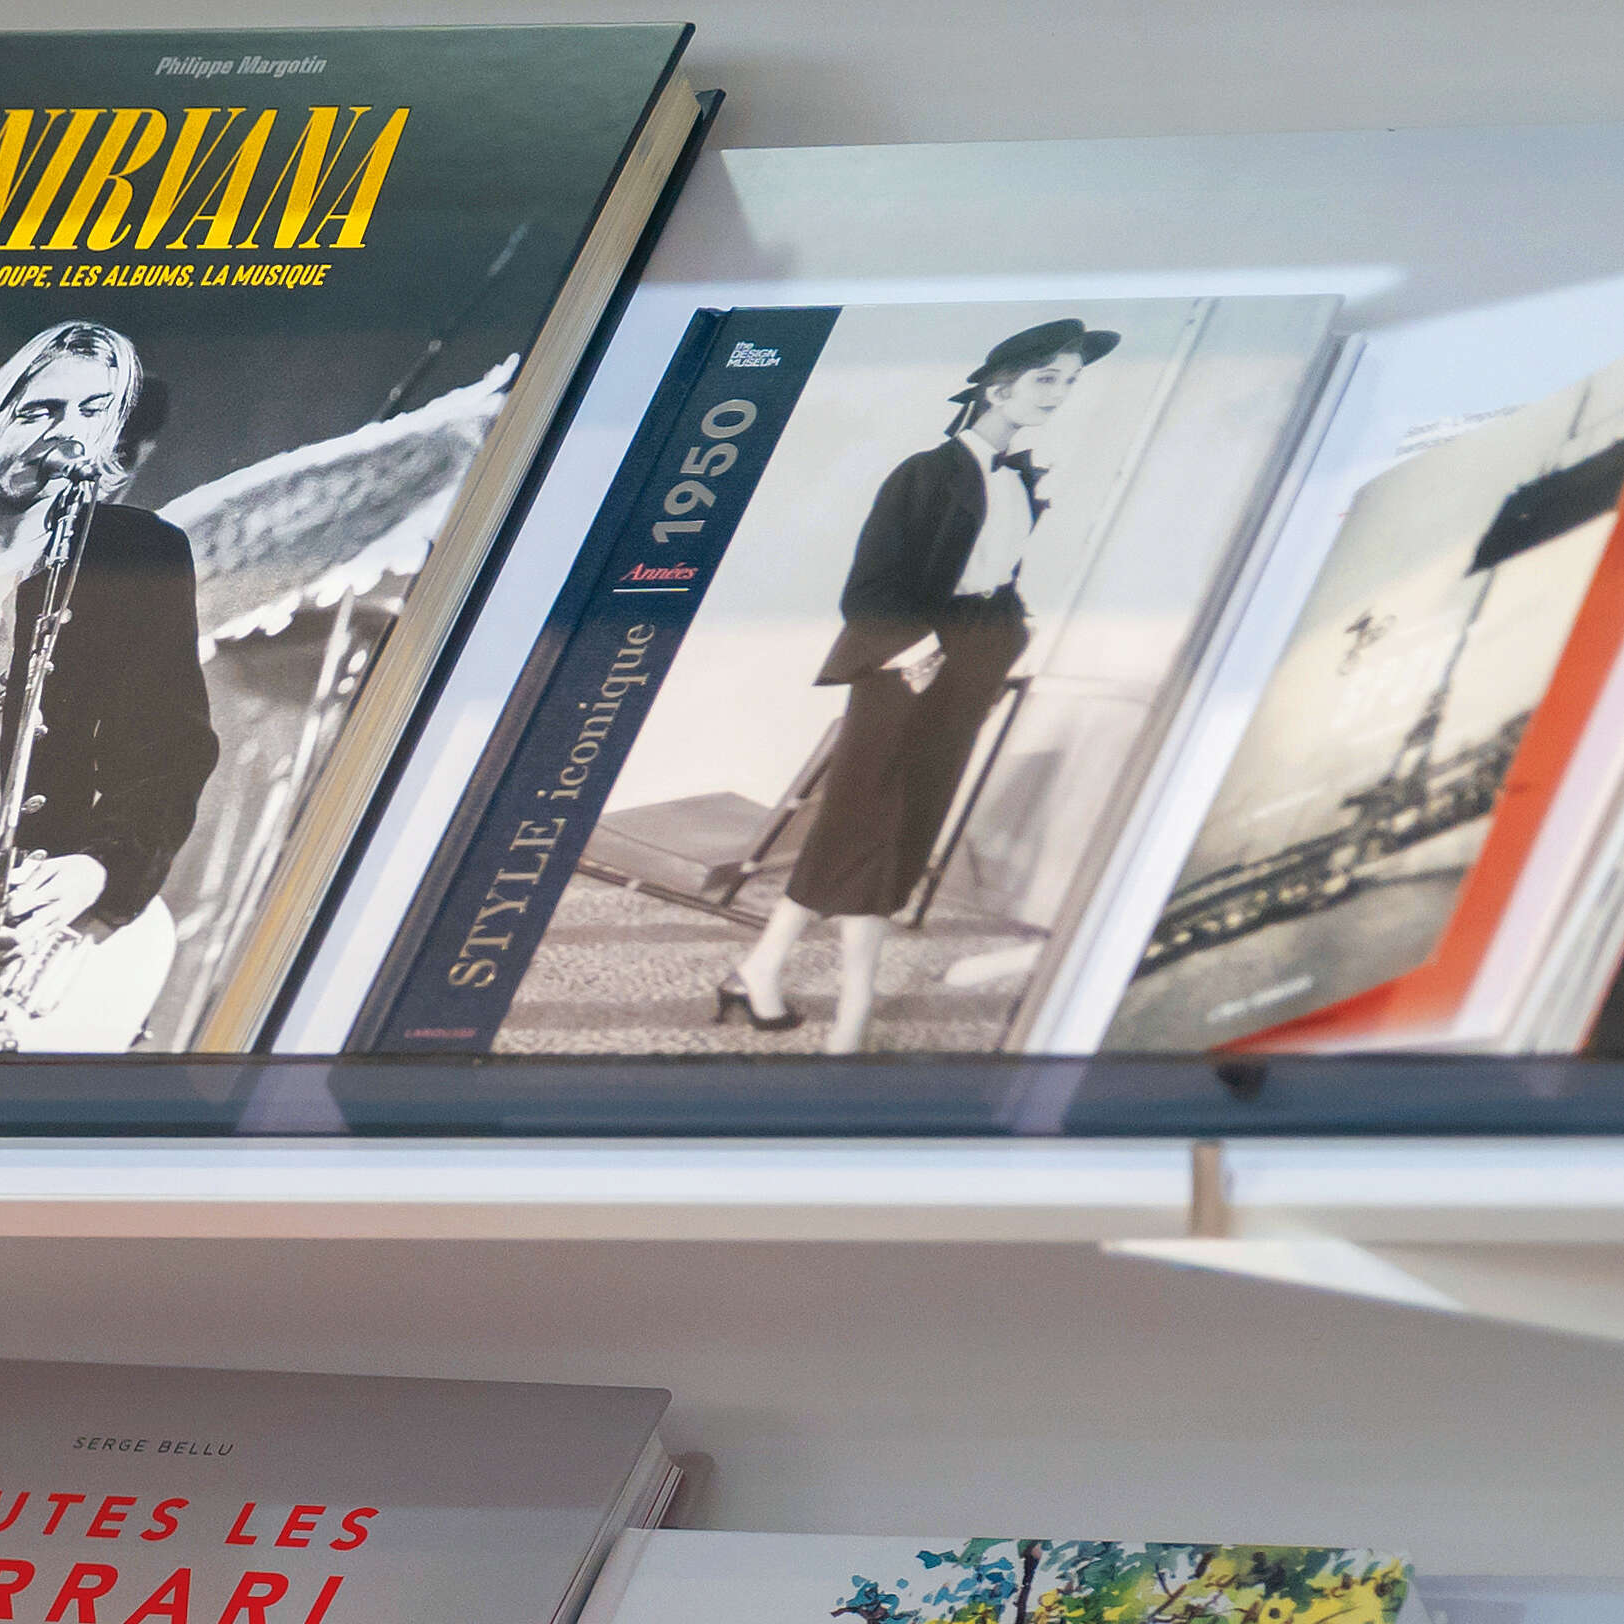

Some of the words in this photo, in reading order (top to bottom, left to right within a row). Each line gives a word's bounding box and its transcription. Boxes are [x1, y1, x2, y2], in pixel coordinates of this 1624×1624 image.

[154, 56, 235, 79] Philippe
[236, 55, 328, 78] Margotin
[59, 264, 101, 288] LES
[102, 264, 195, 290] ALBUMS,
[200, 264, 232, 288] LA
[232, 263, 332, 289] MUSIQUE
[726, 357, 782, 368] MUSEUM
[731, 348, 779, 359] DESIGN
[650, 398, 757, 544] 1950
[619, 561, 699, 581] Années
[448, 817, 569, 990] STYLE
[536, 623, 656, 800] iconique
[73, 1435, 148, 1454] SERGE
[157, 1439, 235, 1457] BELLU
[224, 1501, 380, 1551] LES
